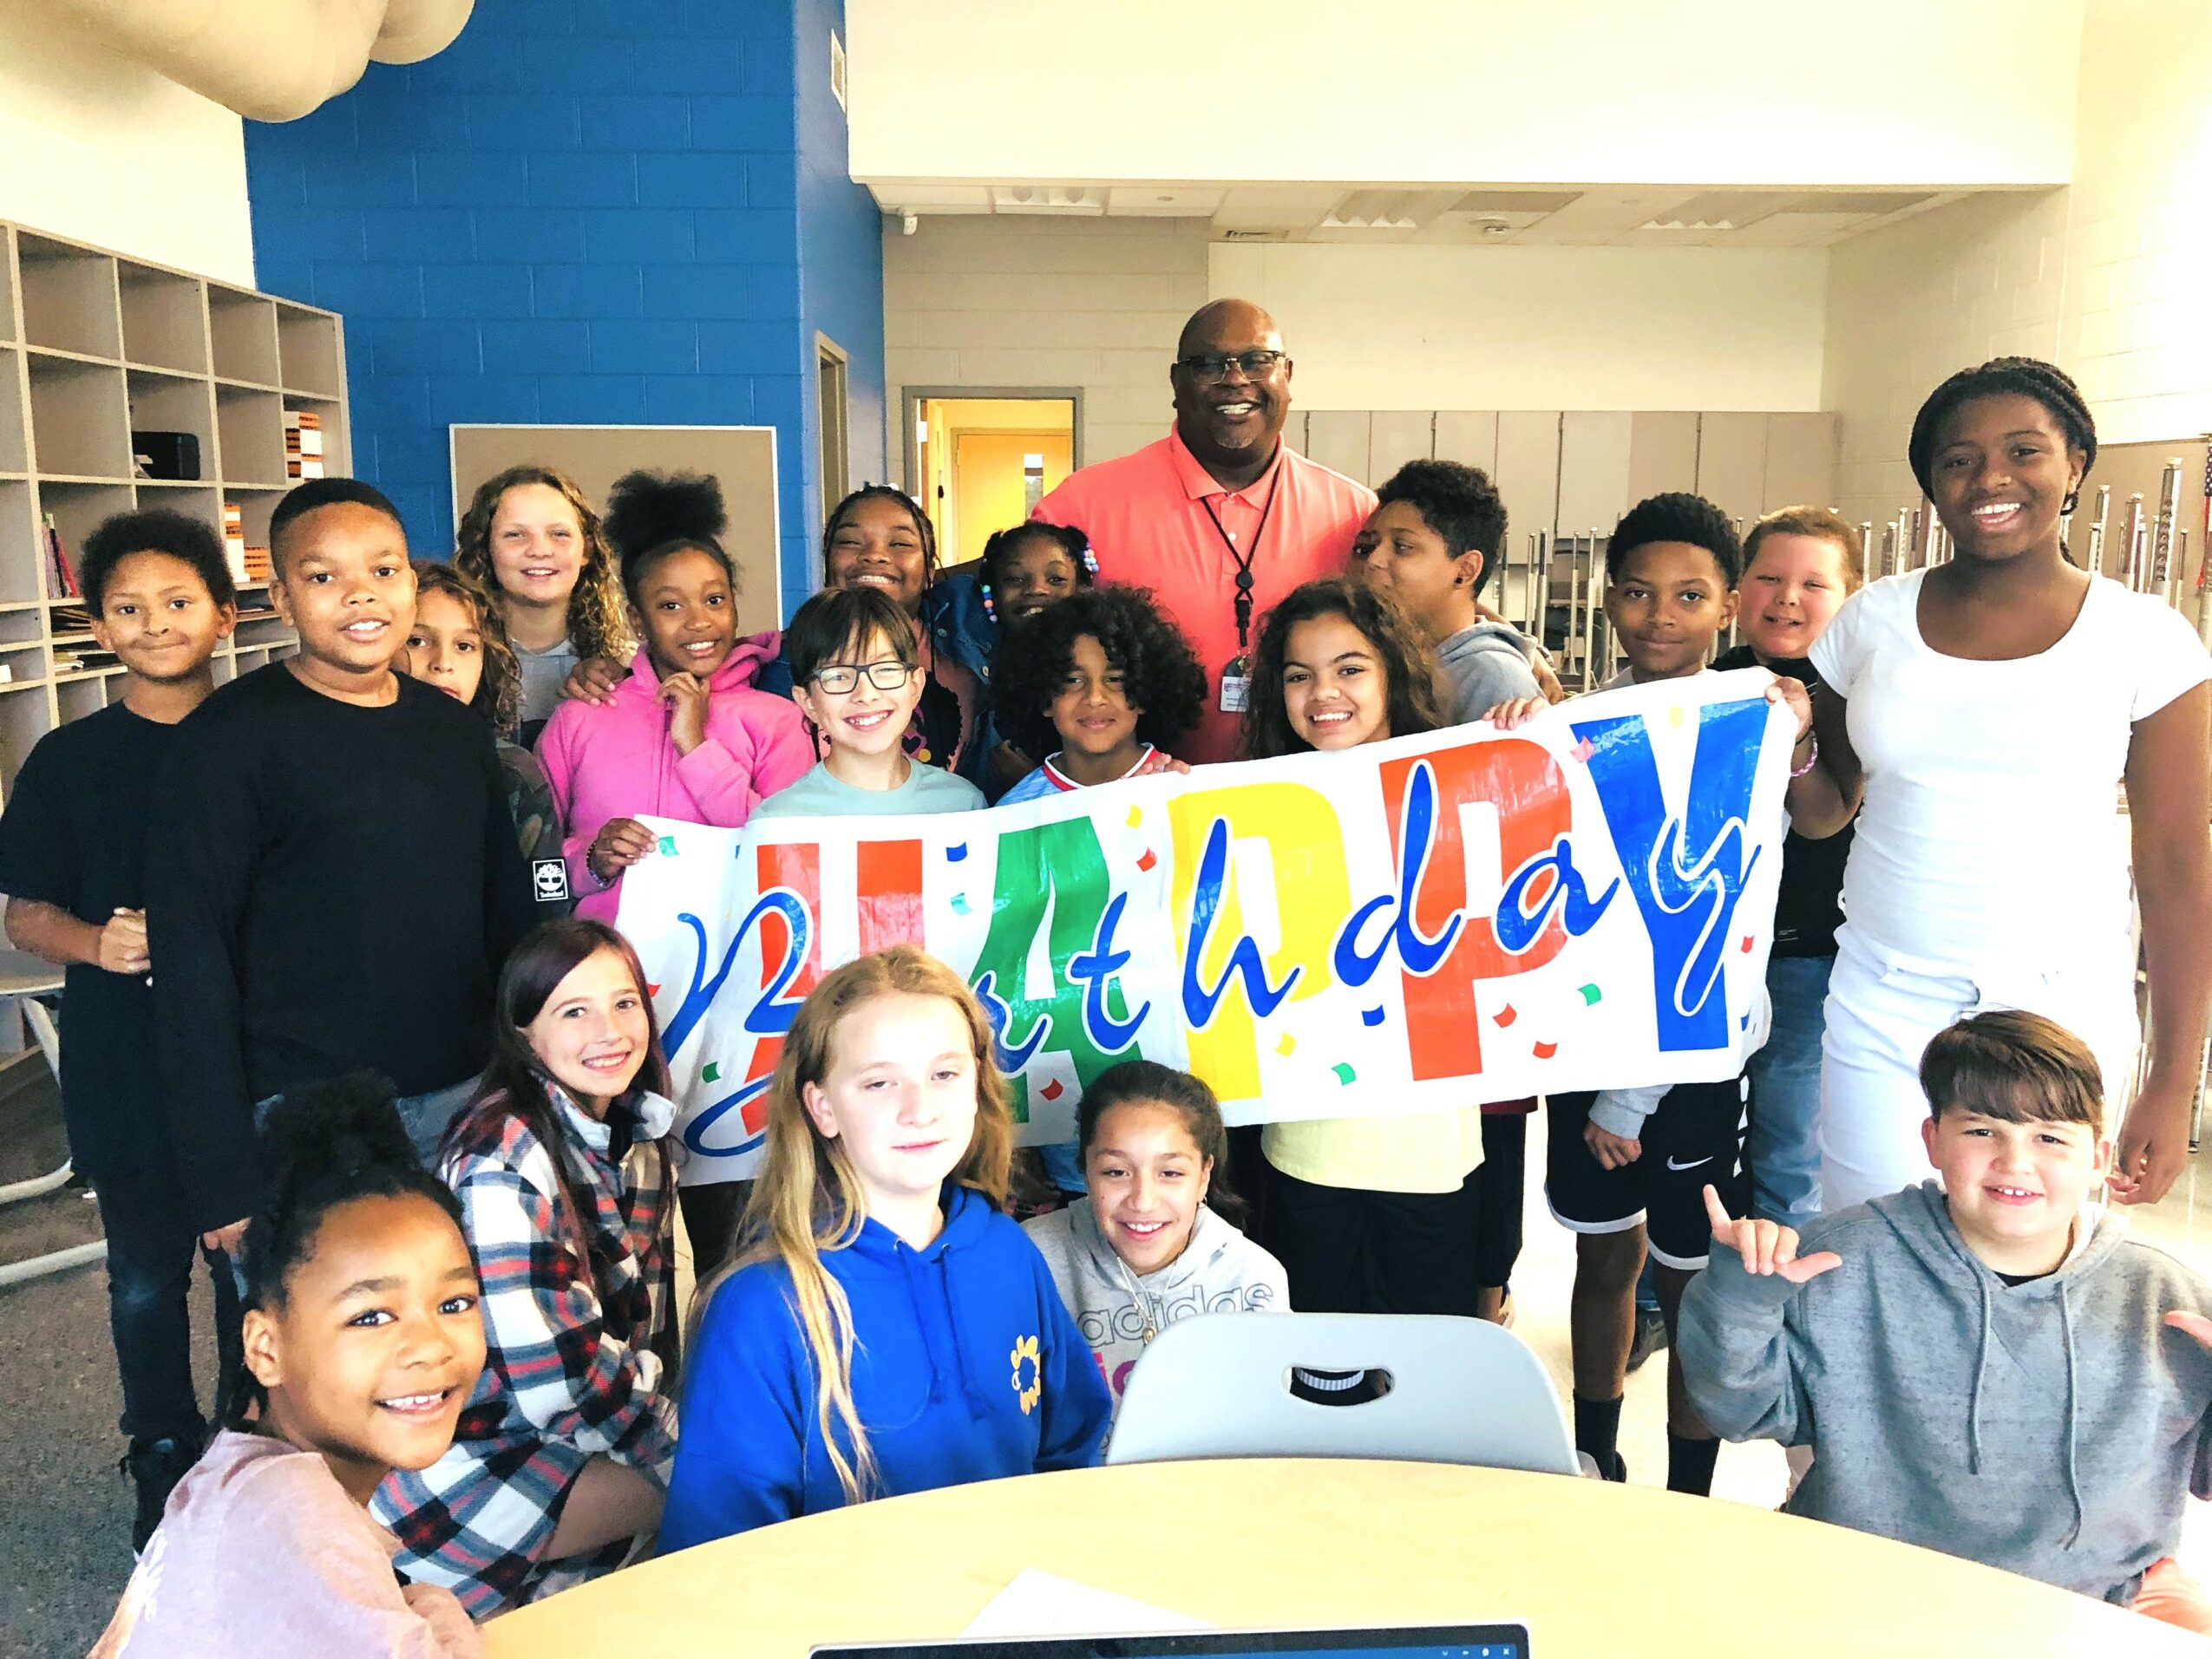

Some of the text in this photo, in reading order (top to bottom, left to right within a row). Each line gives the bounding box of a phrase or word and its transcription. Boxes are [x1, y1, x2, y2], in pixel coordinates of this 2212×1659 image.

[662, 763, 1761, 1157] Brthday
[740, 696, 1774, 1136] HAPPY
[1077, 1283, 1274, 1348] adidas
